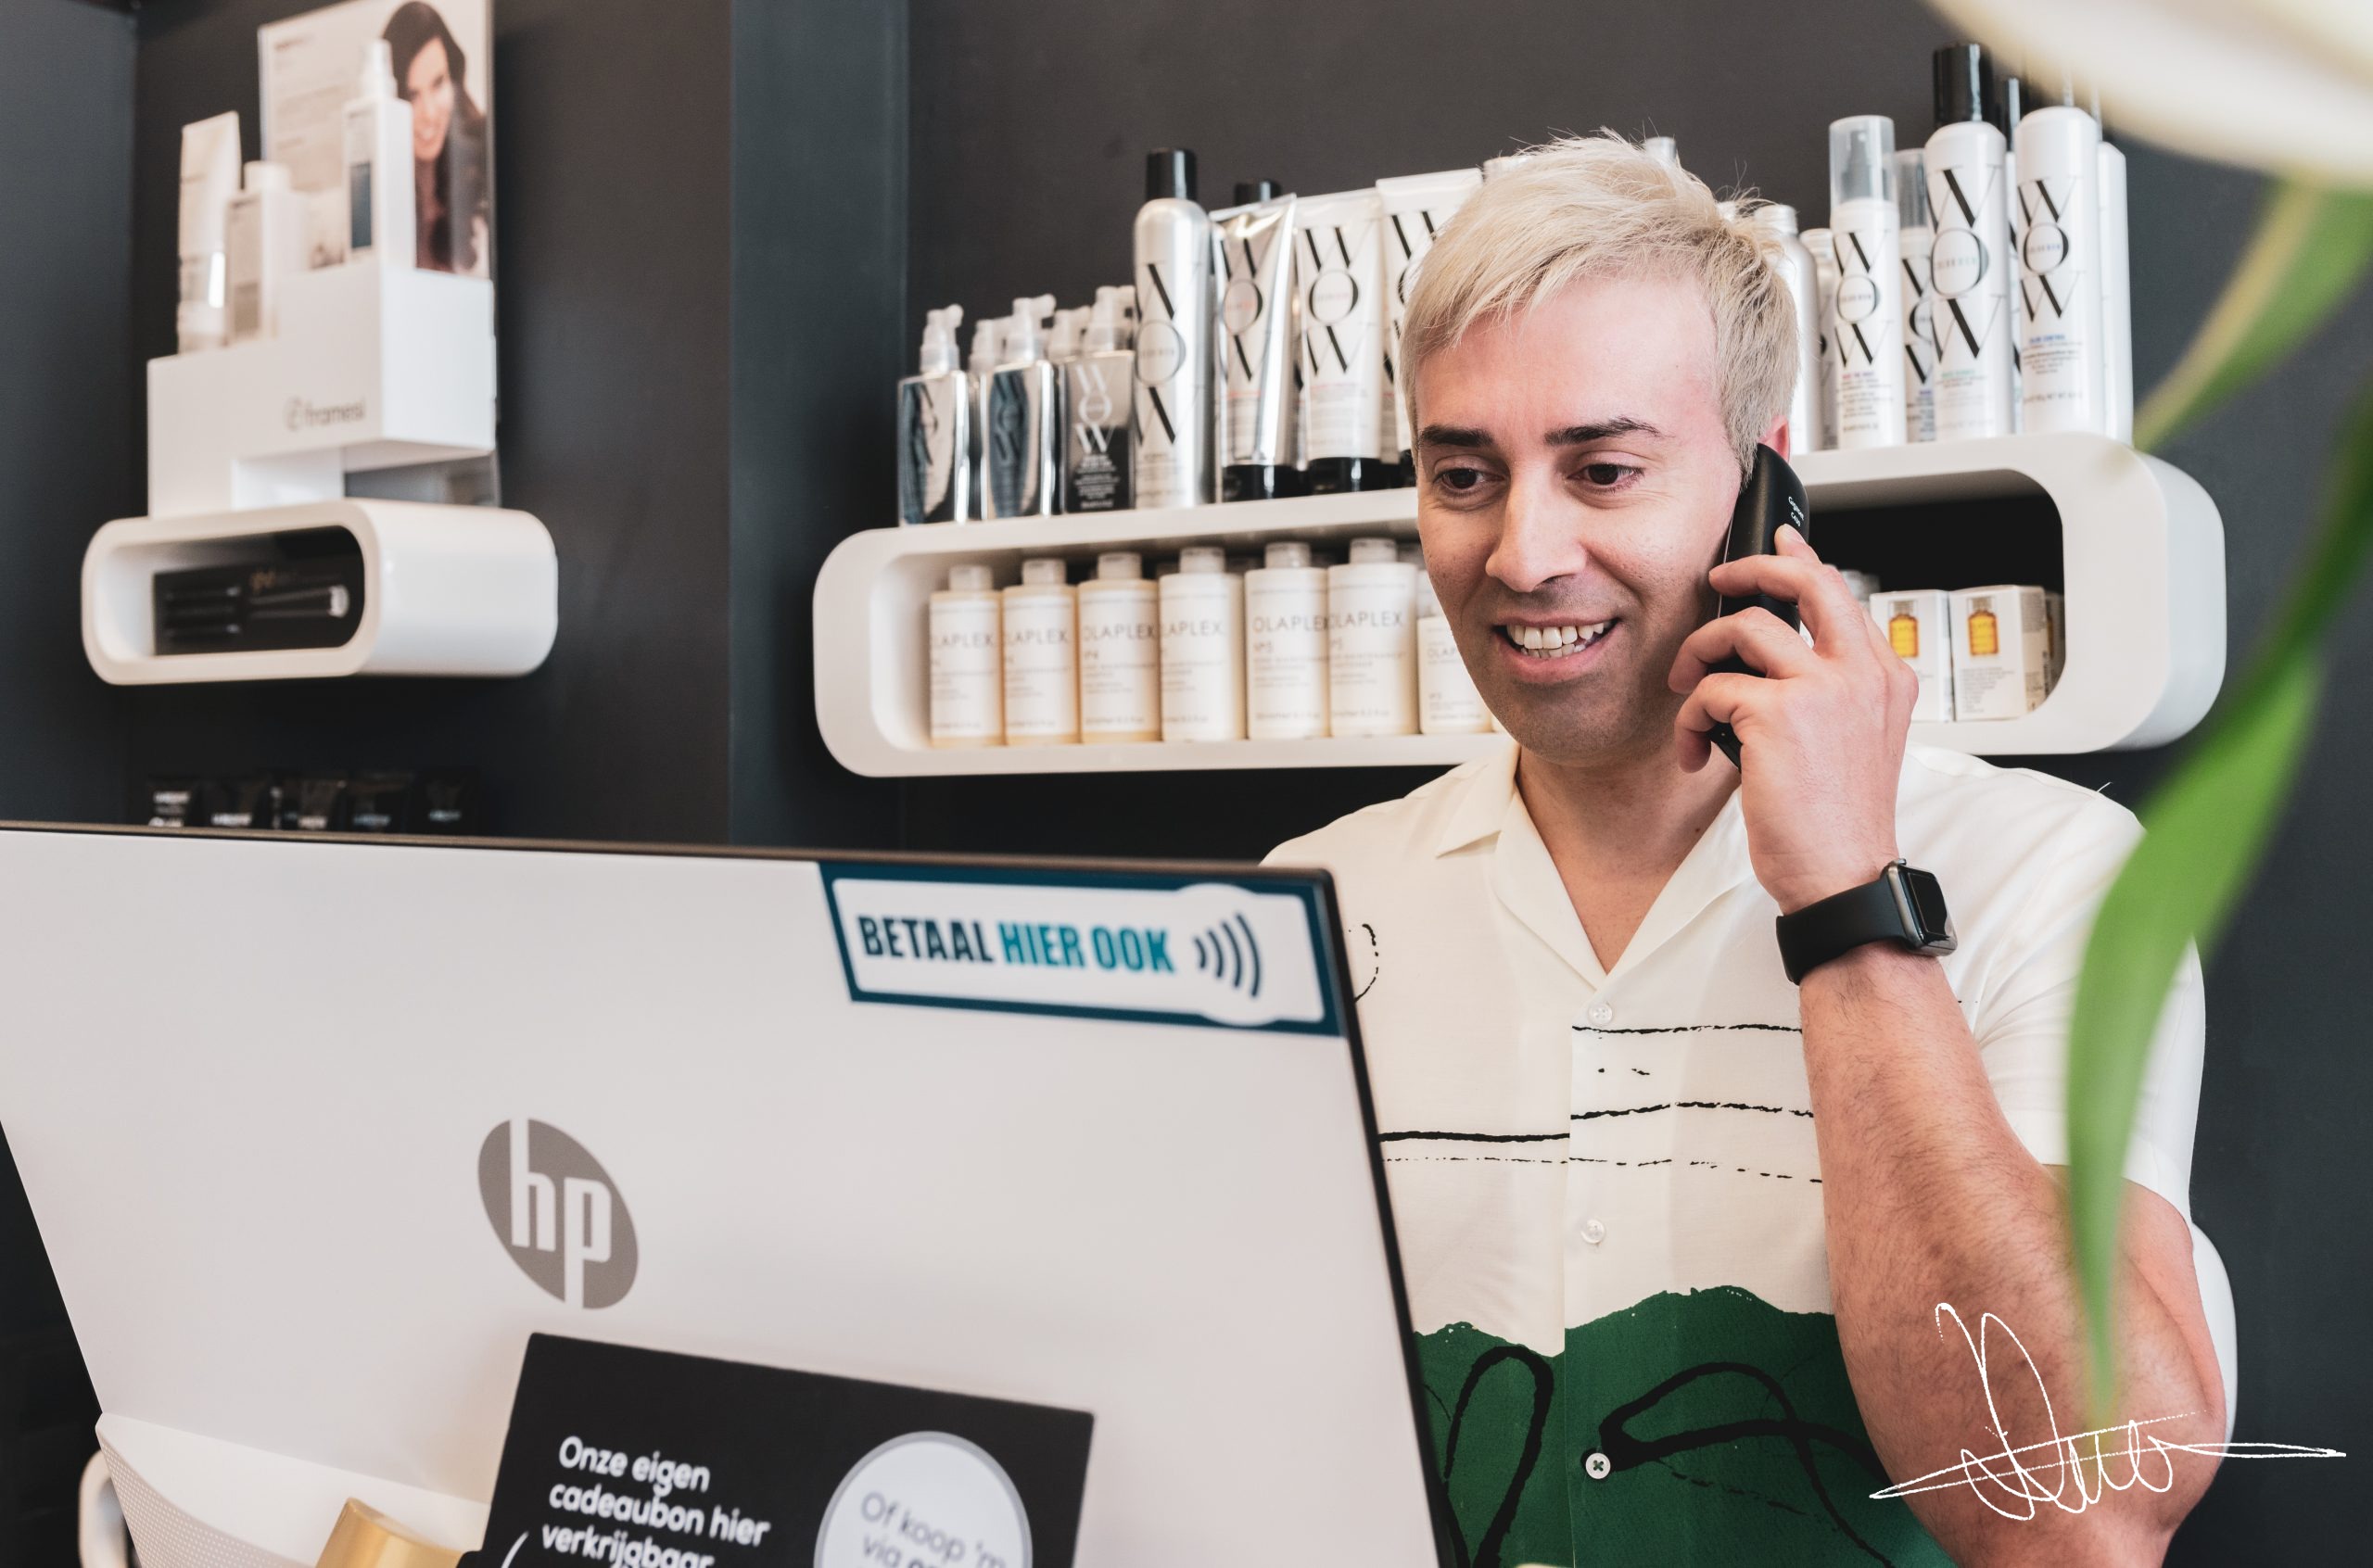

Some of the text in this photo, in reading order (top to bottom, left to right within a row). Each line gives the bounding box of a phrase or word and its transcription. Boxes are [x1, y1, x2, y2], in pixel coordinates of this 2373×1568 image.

[1304, 220, 1374, 375] WOW
[1075, 362, 1118, 453] WOW
[857, 915, 1176, 972] BETAAL HIER OOK
[508, 1118, 613, 1310] hp
[558, 1435, 711, 1498] Onze eigen
[549, 1483, 772, 1548] cadeaubon hier
[860, 1491, 899, 1527] Of
[899, 1507, 966, 1564] koop
[863, 1532, 902, 1568] via
